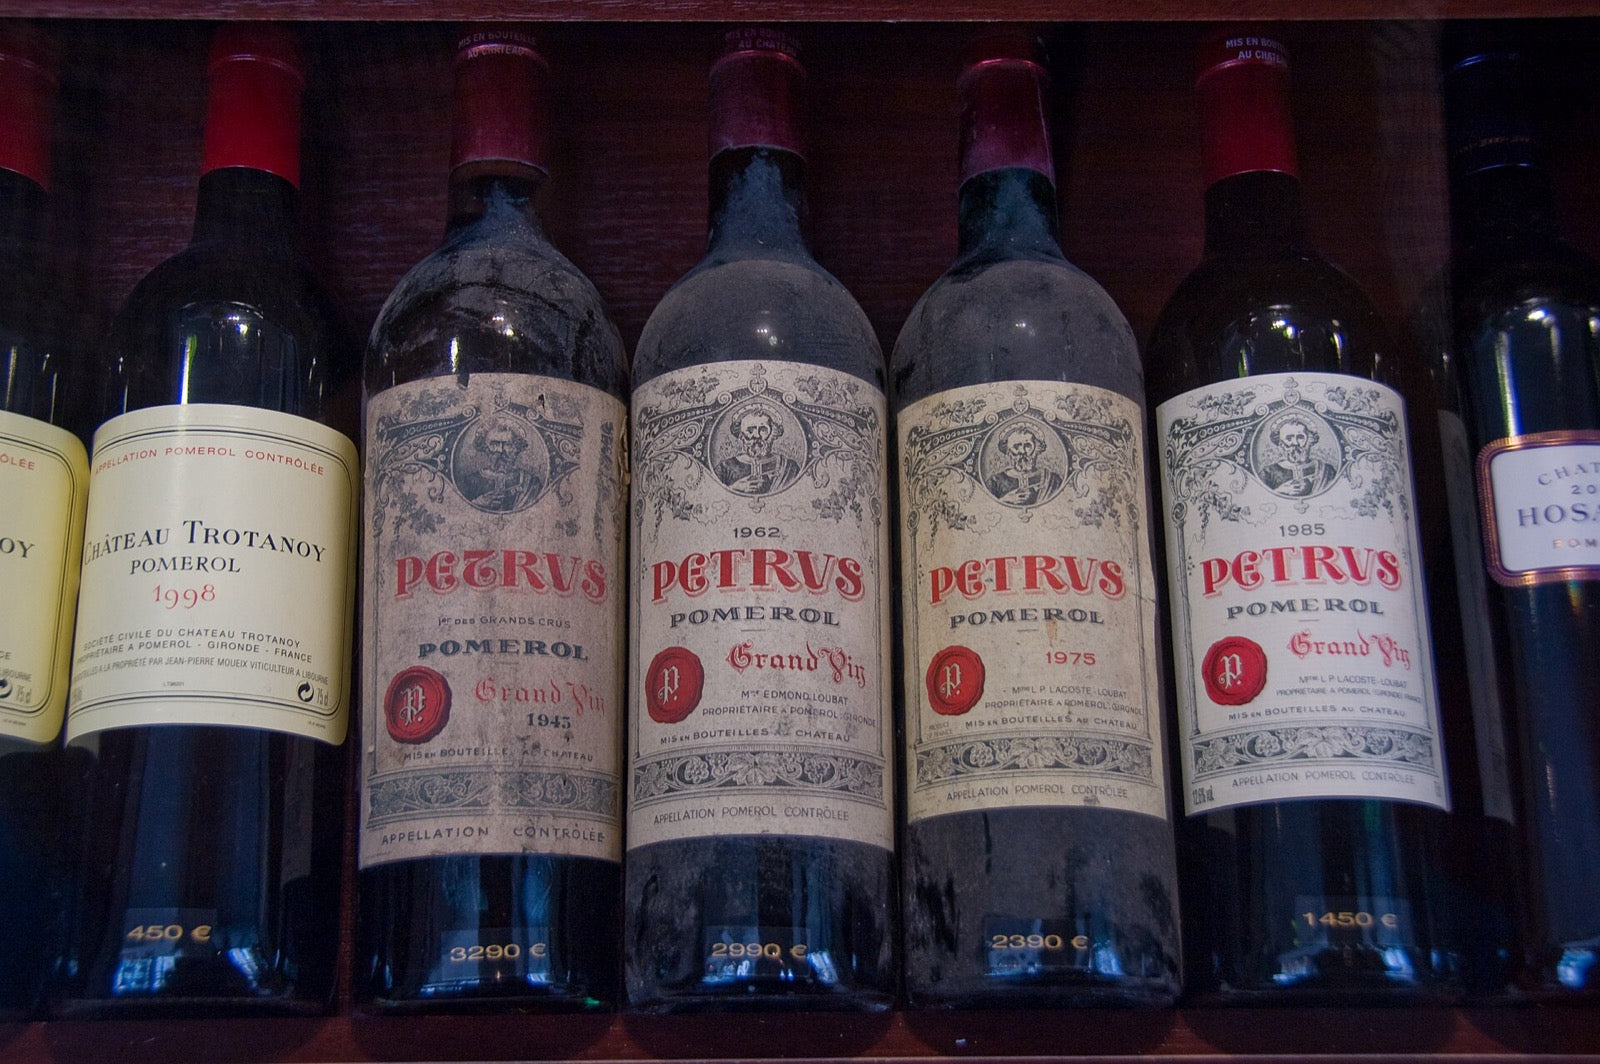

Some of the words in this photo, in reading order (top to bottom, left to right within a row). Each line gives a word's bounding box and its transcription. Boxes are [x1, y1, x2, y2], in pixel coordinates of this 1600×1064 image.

[1226, 38, 1244, 48] MIS
[1246, 37, 1259, 46] EN
[1238, 50, 1252, 59] AU
[165, 447, 236, 457] POMEROL
[733, 527, 781, 538] 1962
[1279, 523, 1326, 537] 1985
[183, 519, 326, 563] TROTANOY
[130, 556, 241, 575] POMEROL
[152, 584, 216, 609] 1998
[670, 606, 840, 628] POMEROL
[950, 608, 1104, 628] POMEROL
[1227, 598, 1384, 620] POMEROL
[454, 617, 476, 626] DES
[480, 616, 535, 626] GRANDS
[538, 618, 571, 629] CRUS
[118, 629, 151, 641] CIVILE
[157, 629, 173, 637] DU
[178, 628, 235, 639] CHATEAU
[241, 631, 300, 648] TROTANOY
[1287, 628, 1370, 660] Grand
[139, 640, 192, 649] POMEROL
[207, 641, 260, 653] GIRONDE
[274, 648, 312, 663] FRANCE
[417, 639, 588, 660] POMEROL
[726, 640, 818, 673] Grand
[1046, 652, 1096, 665] 1975
[526, 712, 571, 729] 1945
[1228, 711, 1249, 721] MIS
[1264, 704, 1337, 716] BOUTEILLES
[1360, 705, 1406, 718] CHATEAU
[965, 719, 985, 730] MIS
[1001, 715, 1073, 726] BOUTEILLES
[1093, 717, 1137, 730] CHATEAU
[660, 735, 678, 745] MIS
[693, 727, 769, 740] BOUTEILLES
[796, 729, 851, 742] CHATEAU
[1232, 772, 1298, 788] APPELLATION
[1305, 770, 1356, 781] POMEROL
[947, 786, 1009, 801] APPELLATION
[1015, 784, 1065, 794] POMEROL
[654, 808, 715, 825] APPELLATION
[722, 806, 777, 817] POMEROL
[381, 826, 488, 845] APPELLATION
[1302, 912, 1373, 927] 1450
[126, 924, 183, 941] 450
[992, 934, 1061, 949] 2390
[1071, 935, 1089, 949] €
[450, 943, 520, 961] 3290
[529, 943, 546, 957] €
[711, 943, 781, 958] 2990
[789, 944, 808, 959] €
